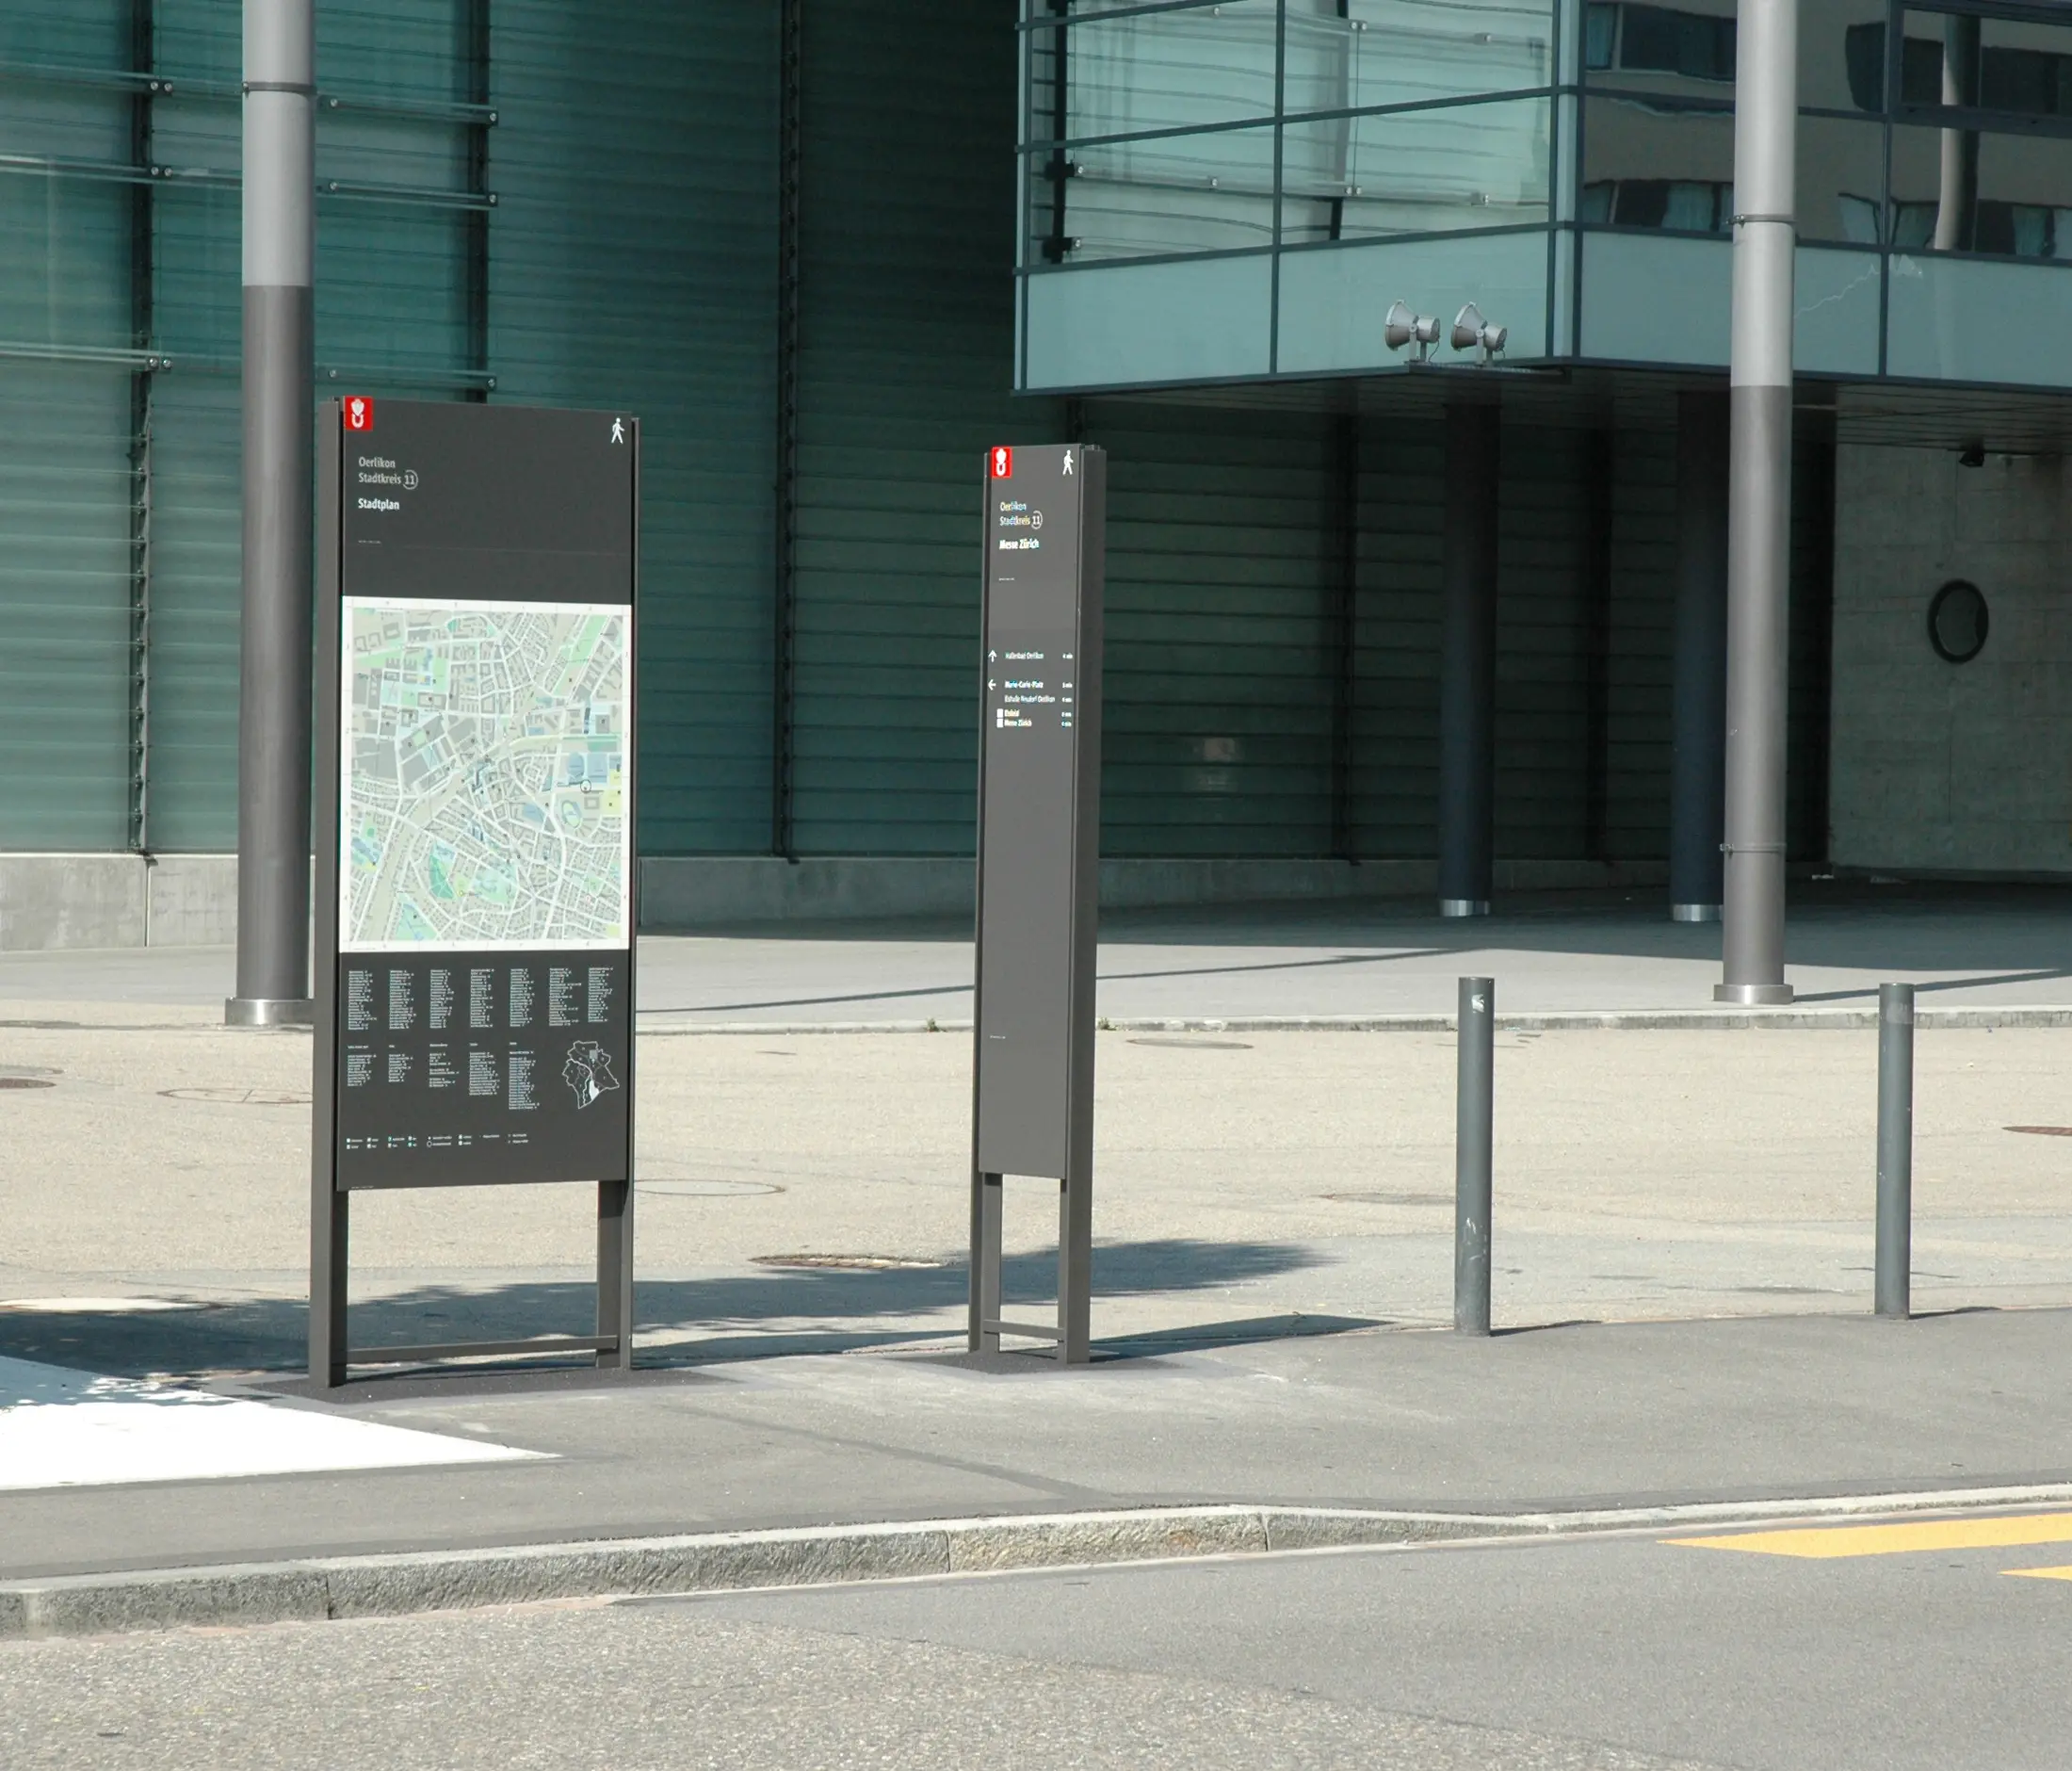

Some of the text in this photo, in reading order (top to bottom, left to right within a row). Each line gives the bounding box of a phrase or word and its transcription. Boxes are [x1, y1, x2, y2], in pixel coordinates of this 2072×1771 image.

[359, 456, 396, 468] Oerlikon
[358, 472, 401, 484] Stadtkreis
[358, 497, 400, 512] Stadtplan
[1000, 501, 1027, 512] Oerlikon
[999, 515, 1030, 526] Stadtkreis
[999, 538, 1040, 550] Messe Zürich
